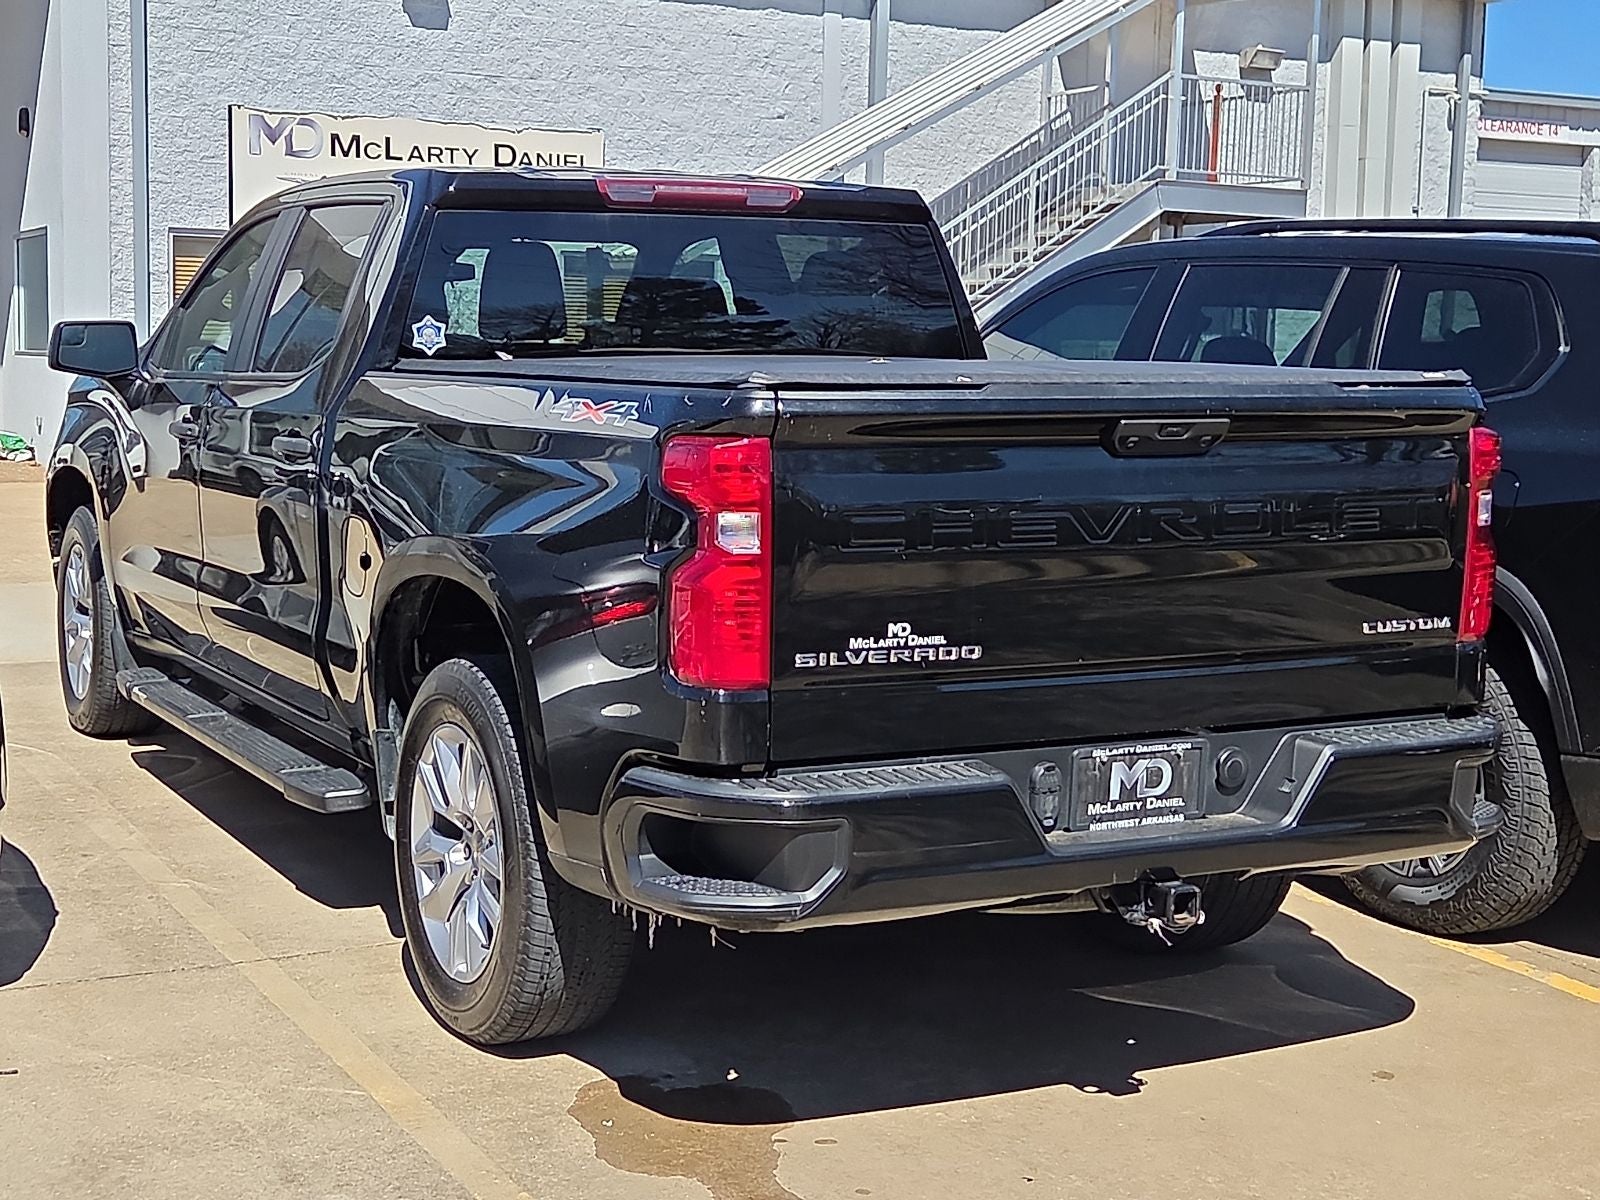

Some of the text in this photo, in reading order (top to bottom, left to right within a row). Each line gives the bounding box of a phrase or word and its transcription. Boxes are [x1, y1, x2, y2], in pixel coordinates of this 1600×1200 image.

[250, 114, 324, 159] MD
[1476, 119, 1543, 136] CLEARANCE
[838, 493, 1443, 552] CHEVROLET
[887, 622, 912, 638] MD
[1362, 616, 1452, 635] CUSTOM
[907, 634, 947, 647] DANIEL
[794, 645, 982, 668] SILVERADO
[1109, 758, 1173, 801] MD
[1146, 797, 1185, 810] DANIEL
[1089, 813, 1185, 832] NORTHWEST ARKANSAS
